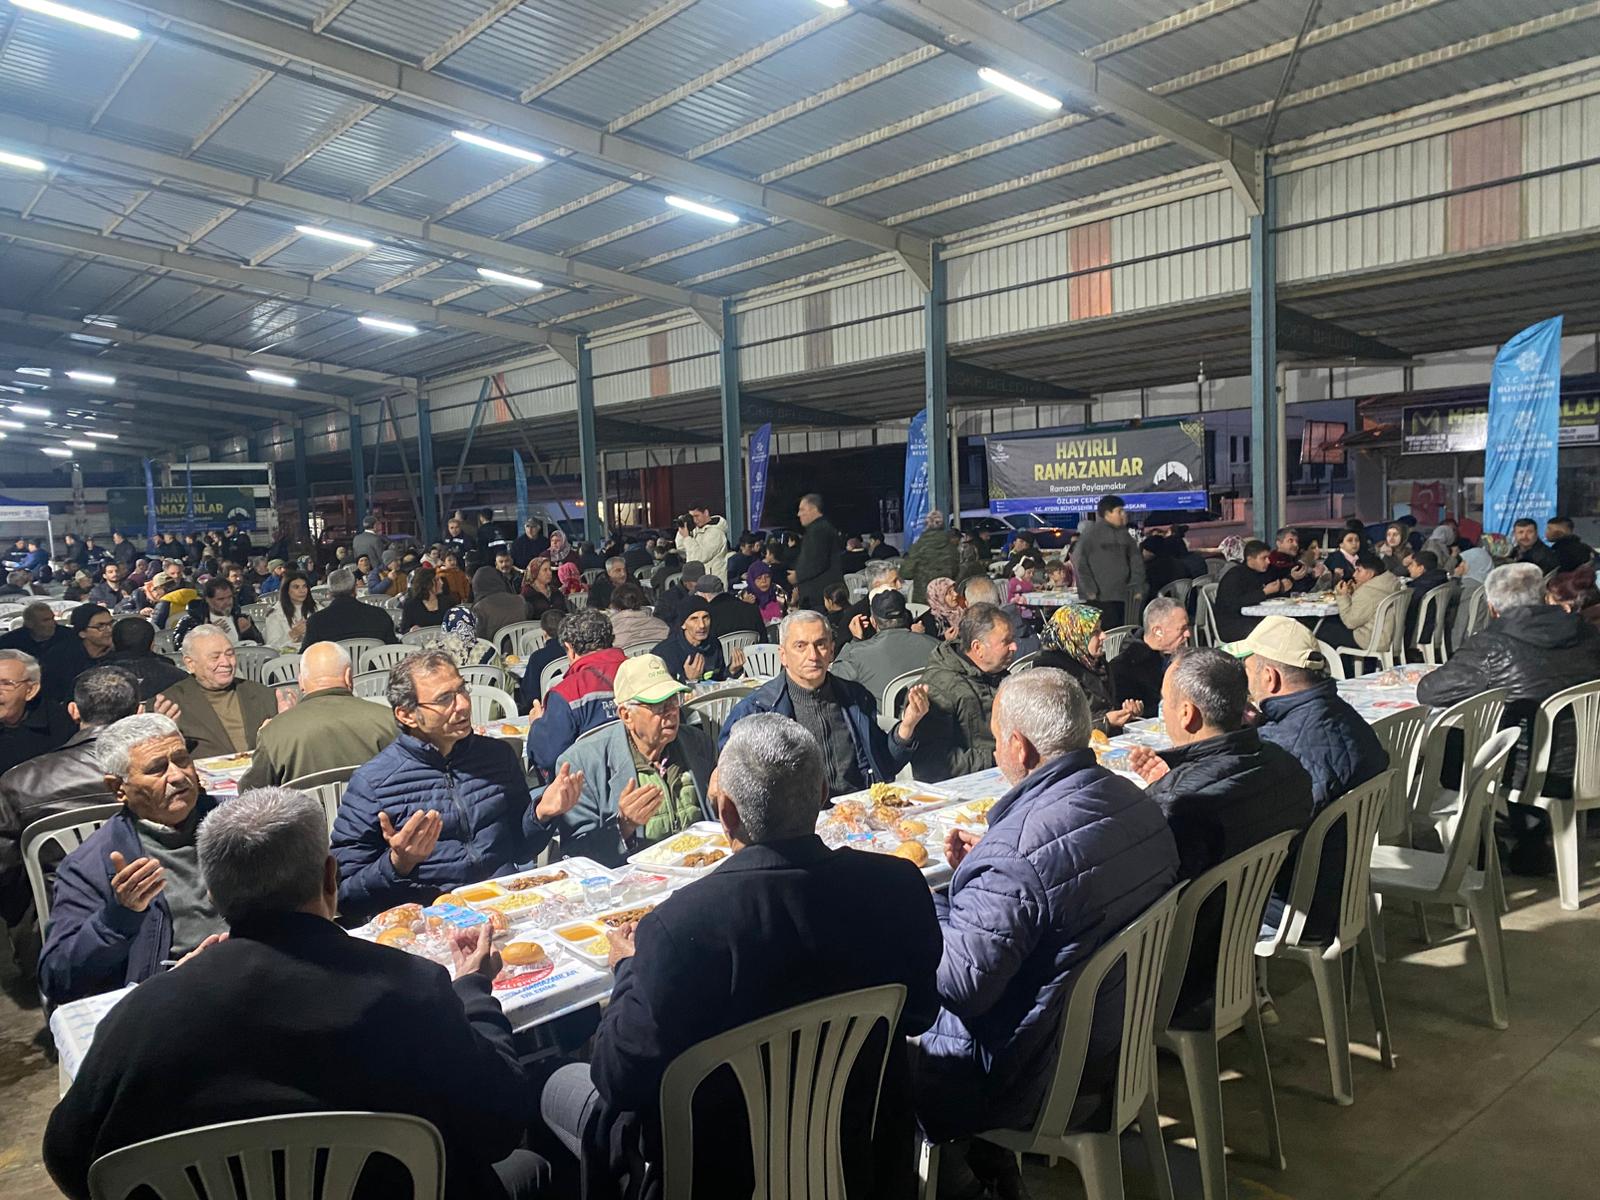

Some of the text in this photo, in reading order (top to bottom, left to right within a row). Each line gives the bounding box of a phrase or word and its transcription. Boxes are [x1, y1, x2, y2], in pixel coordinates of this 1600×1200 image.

[1056, 437, 1117, 459] HAYIRLI
[1034, 456, 1144, 481] RAMAZANLAR
[1050, 482, 1127, 493] Ramazan Paylaşmaktır
